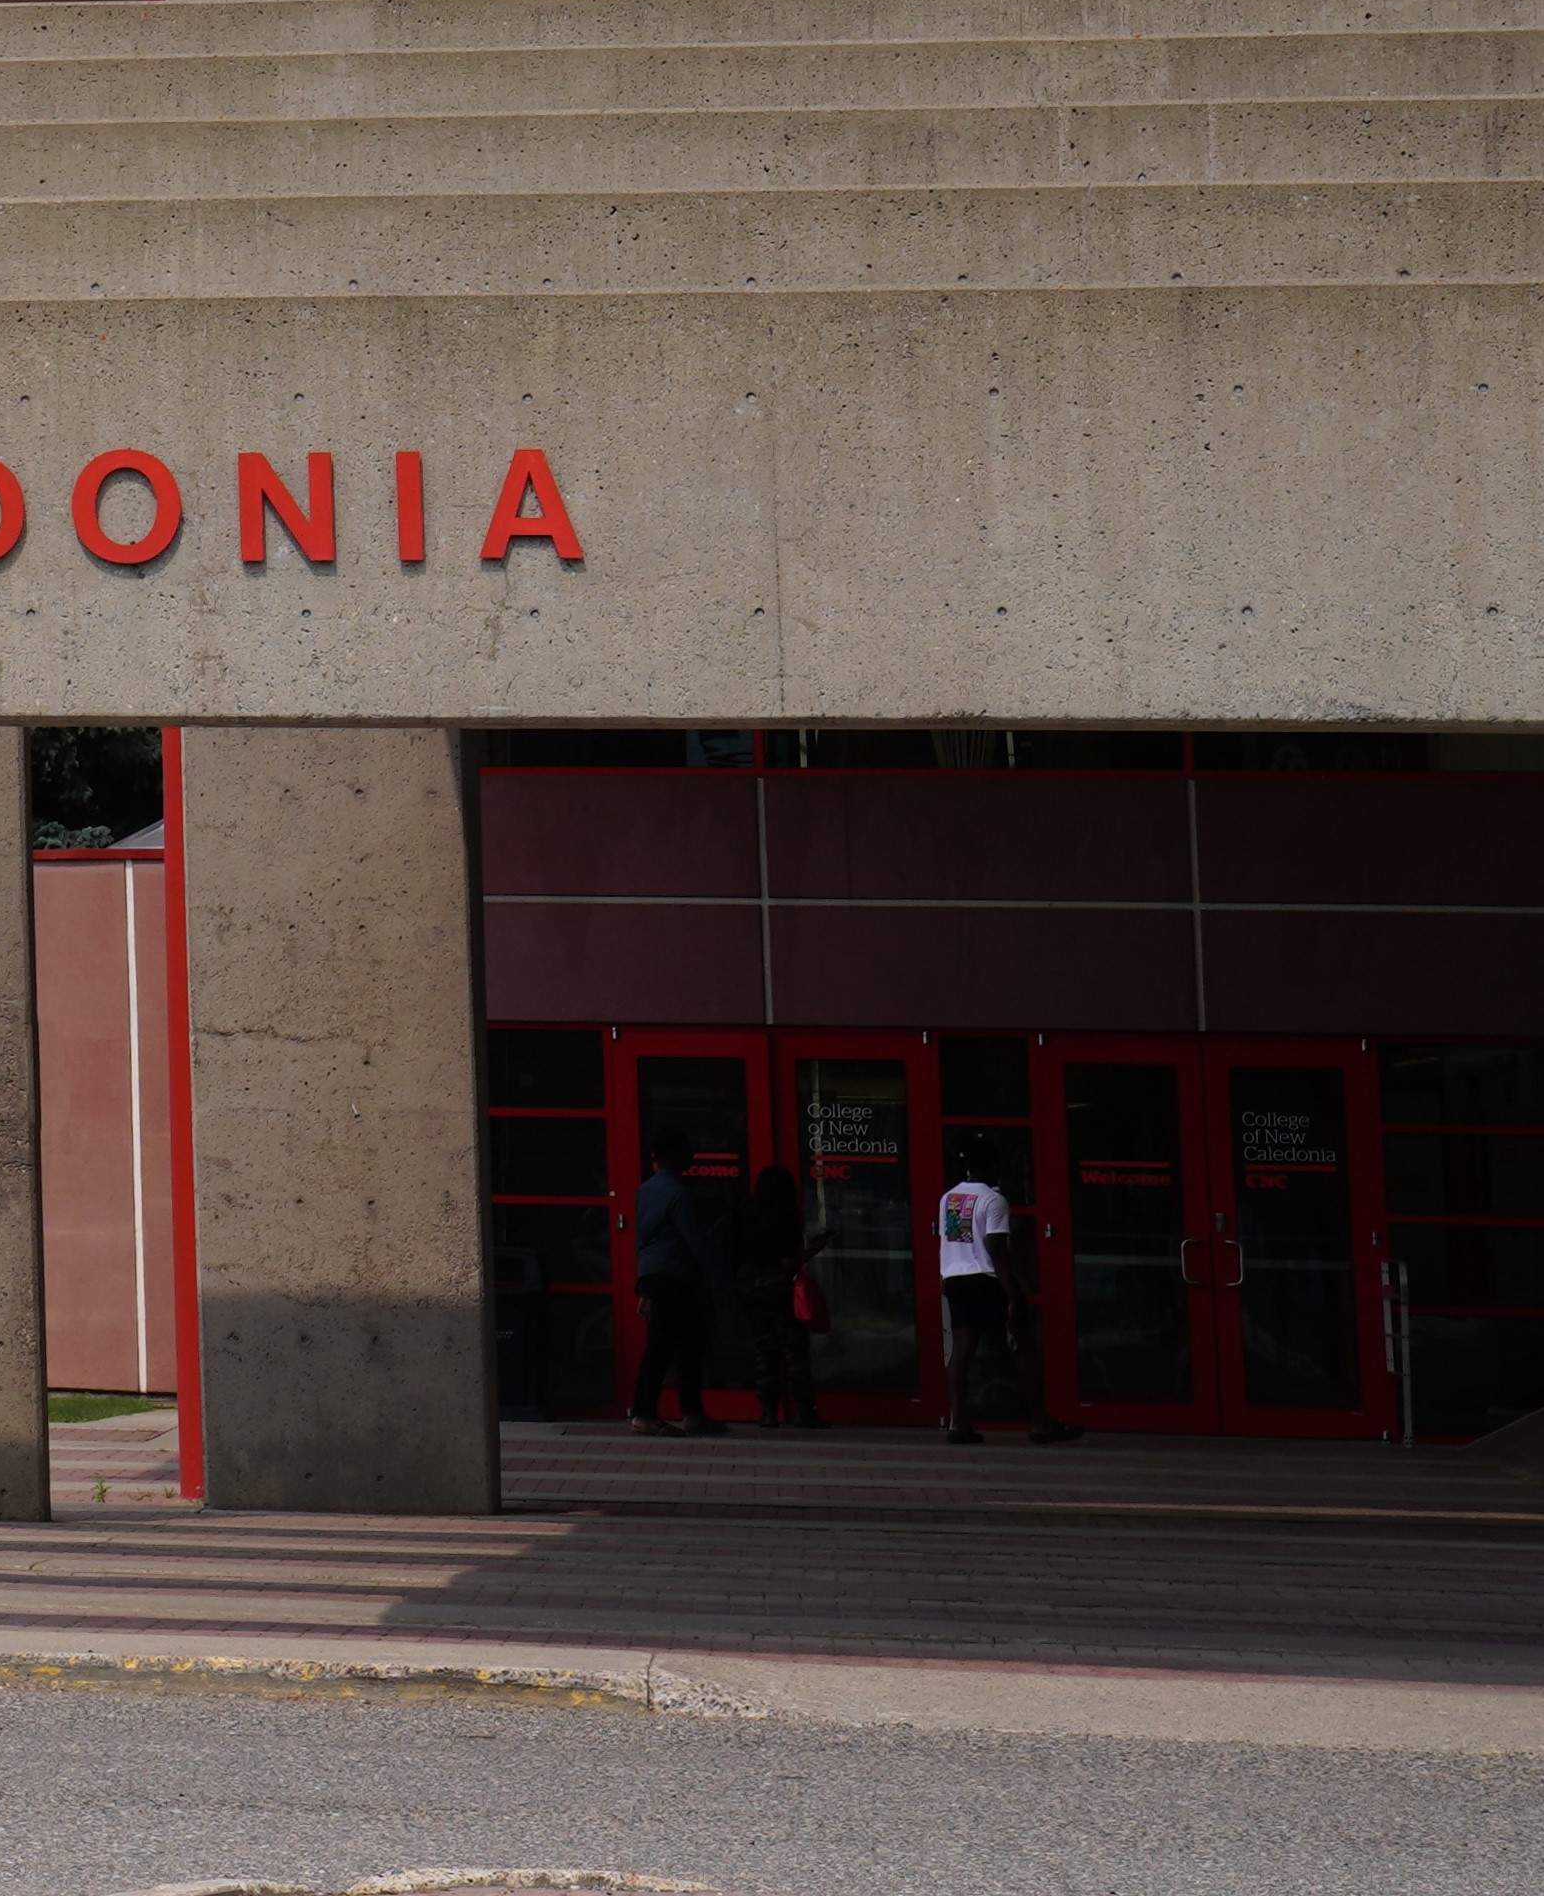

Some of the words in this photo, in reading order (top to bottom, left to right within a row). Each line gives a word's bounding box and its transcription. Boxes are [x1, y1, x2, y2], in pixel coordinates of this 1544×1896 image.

[806, 1102, 874, 1122] College
[1241, 1110, 1311, 1130] College
[807, 1119, 826, 1136] of
[828, 1120, 870, 1137] New
[1242, 1127, 1261, 1145] of
[1264, 1128, 1307, 1146] New
[808, 1136, 899, 1155] Caledonia
[1243, 1145, 1338, 1163] Caledonia
[809, 1164, 852, 1181] CNC
[1079, 1169, 1174, 1187] Welcome
[1244, 1173, 1290, 1189] CNC
